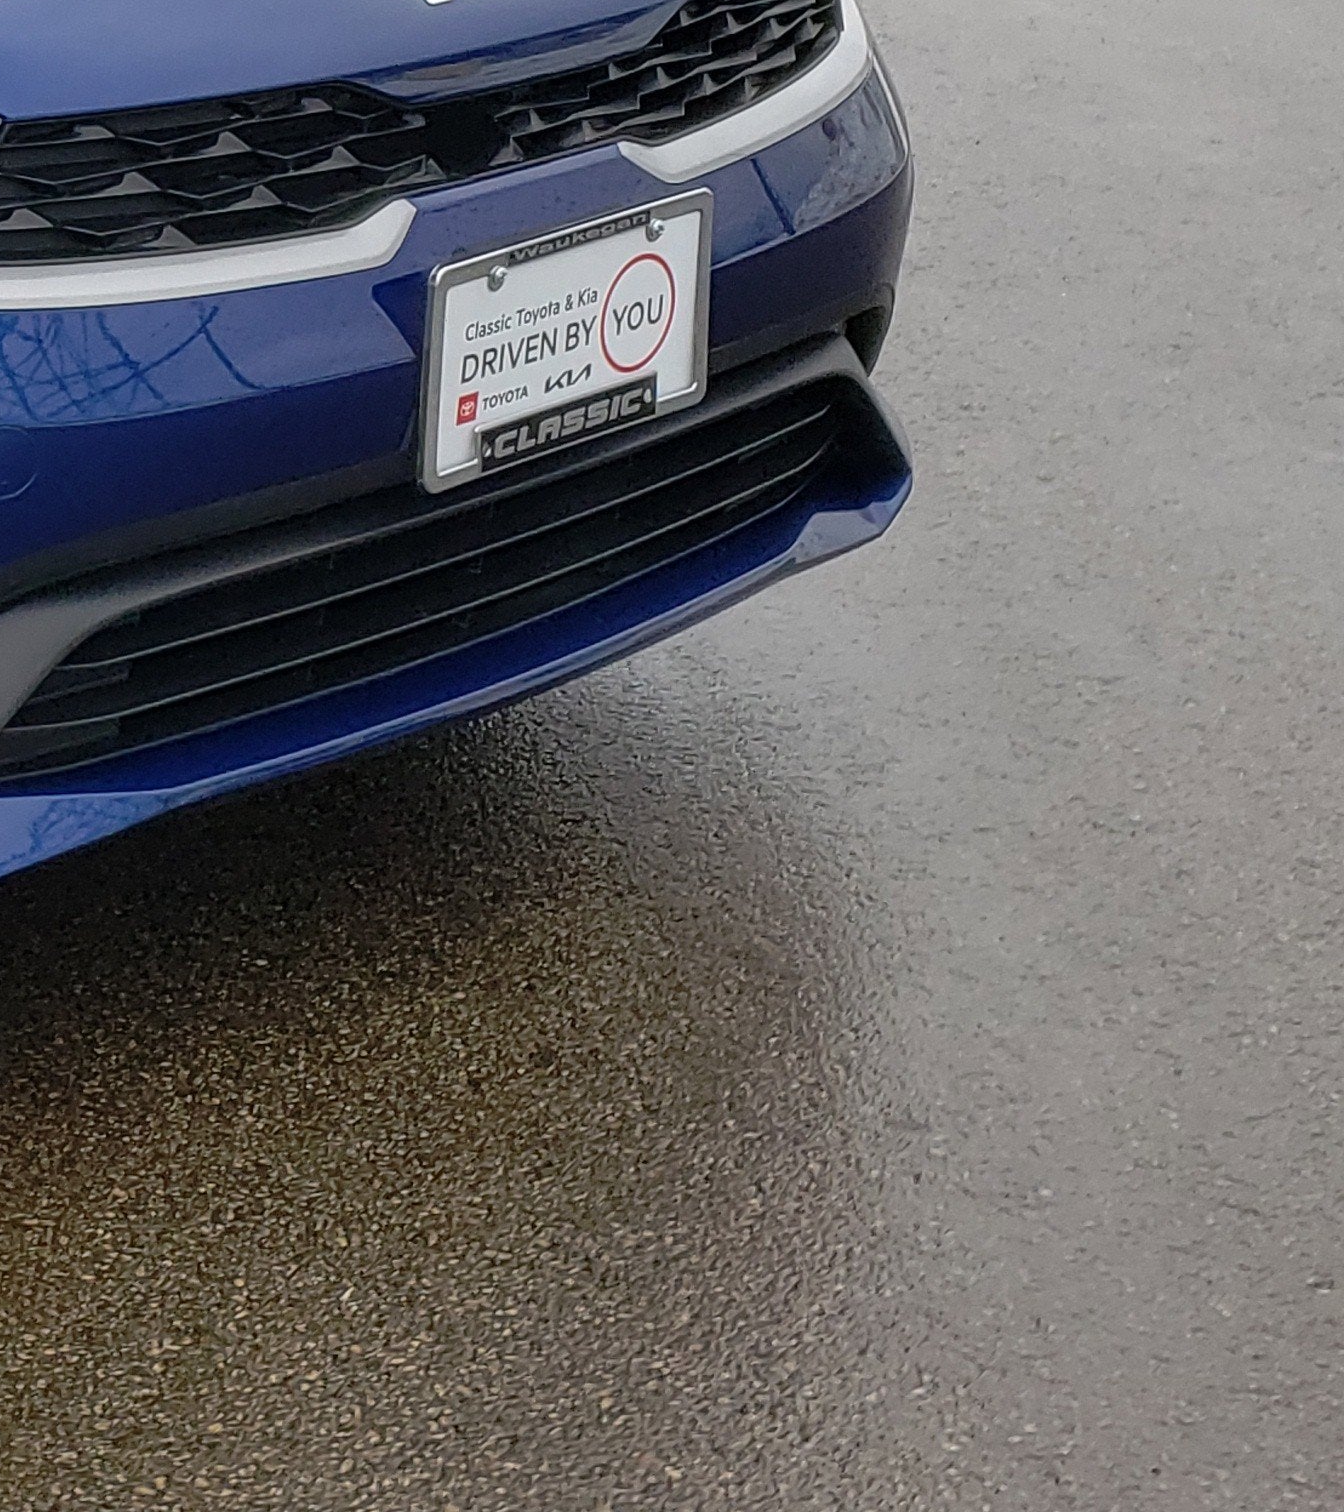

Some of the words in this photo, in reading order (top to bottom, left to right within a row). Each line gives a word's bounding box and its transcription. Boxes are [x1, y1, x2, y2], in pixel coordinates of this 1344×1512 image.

[514, 214, 648, 261] Waukegan
[461, 327, 558, 384] DRIVEN
[564, 315, 598, 352] BY
[612, 294, 664, 336] YOU
[465, 313, 512, 342] Classic
[516, 300, 560, 326] Toyota
[565, 293, 574, 312] &
[577, 287, 598, 311] Kia
[482, 386, 529, 411] TOYOTA
[544, 363, 592, 394] KIA
[493, 387, 644, 460] CLASSIC
